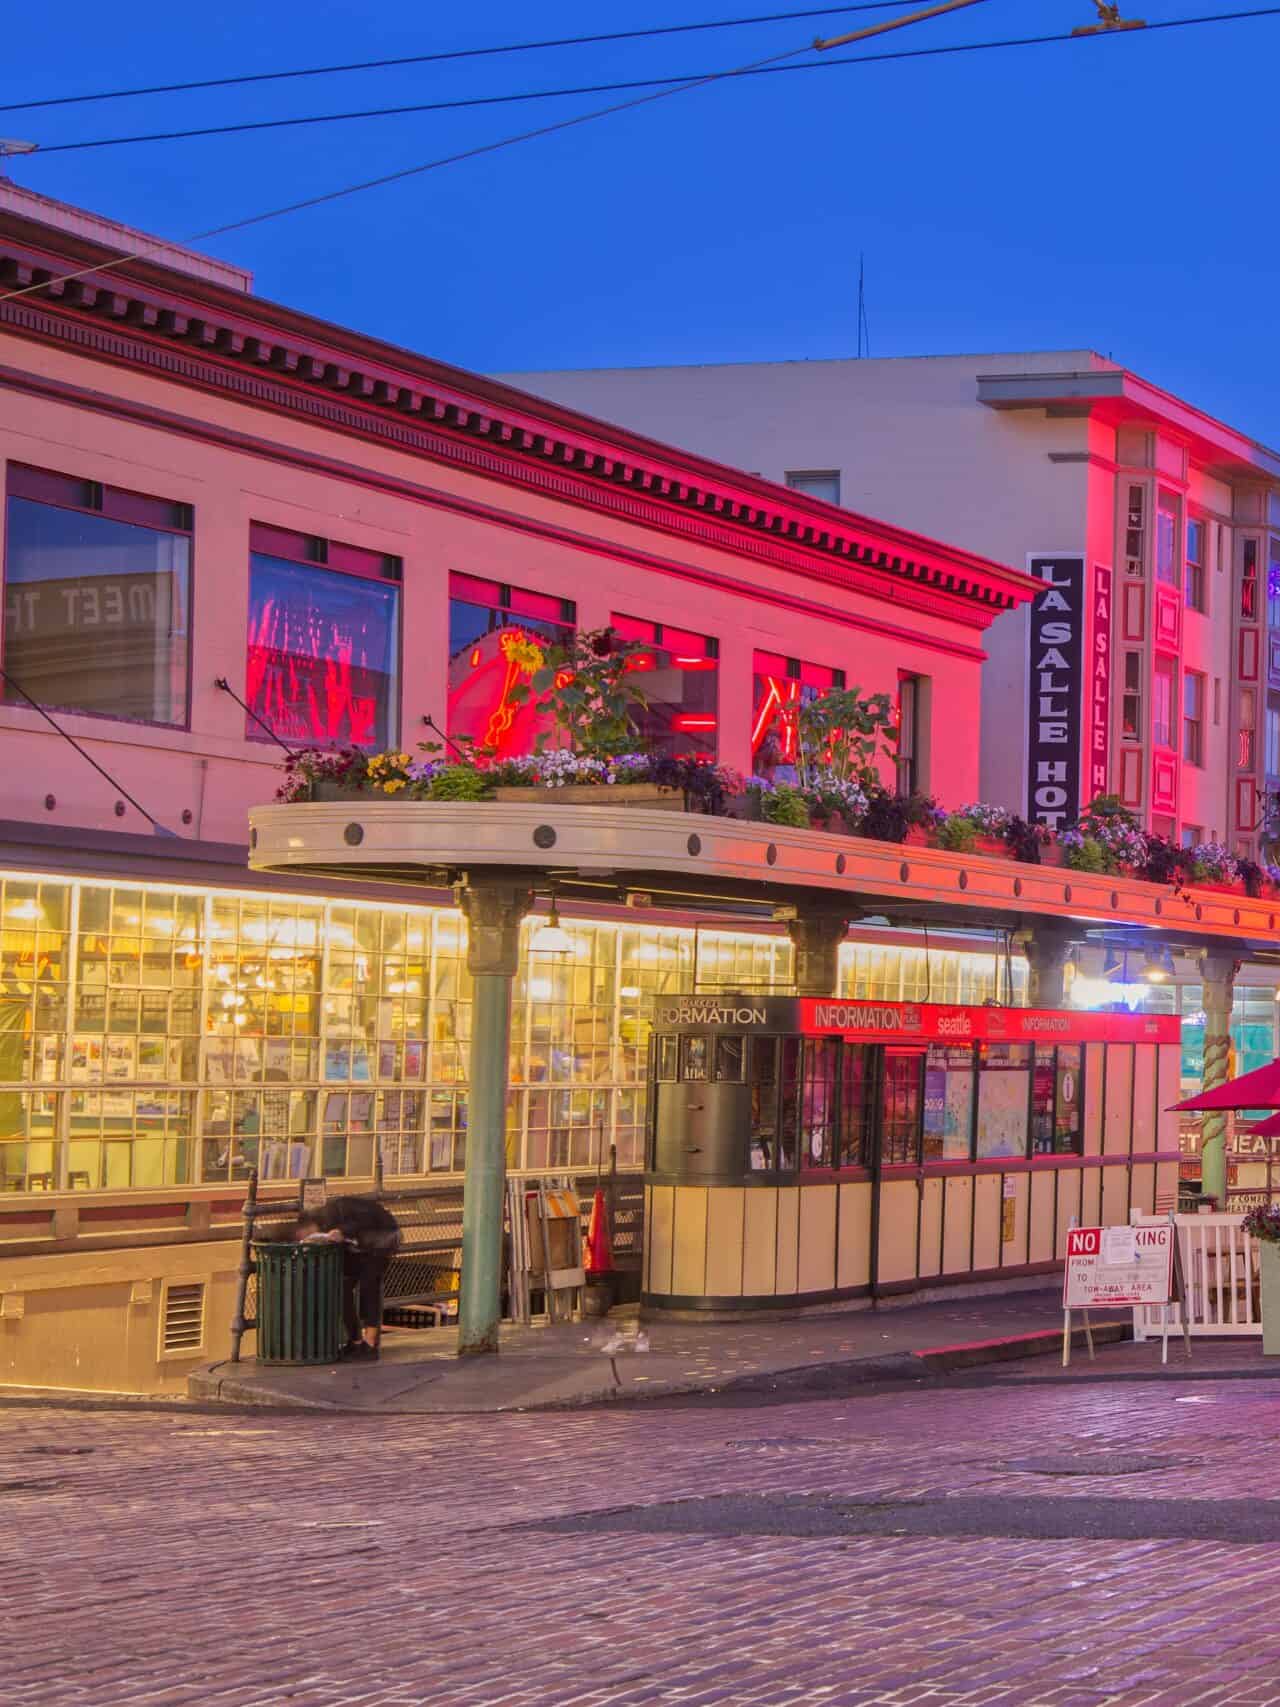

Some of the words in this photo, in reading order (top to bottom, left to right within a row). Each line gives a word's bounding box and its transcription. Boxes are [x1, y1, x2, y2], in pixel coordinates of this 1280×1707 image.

[1038, 566, 1072, 611] LA
[1096, 572, 1108, 618] LA
[1036, 622, 1072, 743] SALLE
[1094, 633, 1107, 751] SALLE
[815, 1004, 903, 1030] INFORMATION
[937, 1013, 971, 1034] seattle
[1072, 1232, 1096, 1253] NO
[1077, 1273, 1088, 1281] TO
[1131, 1283, 1153, 1292] AREA
